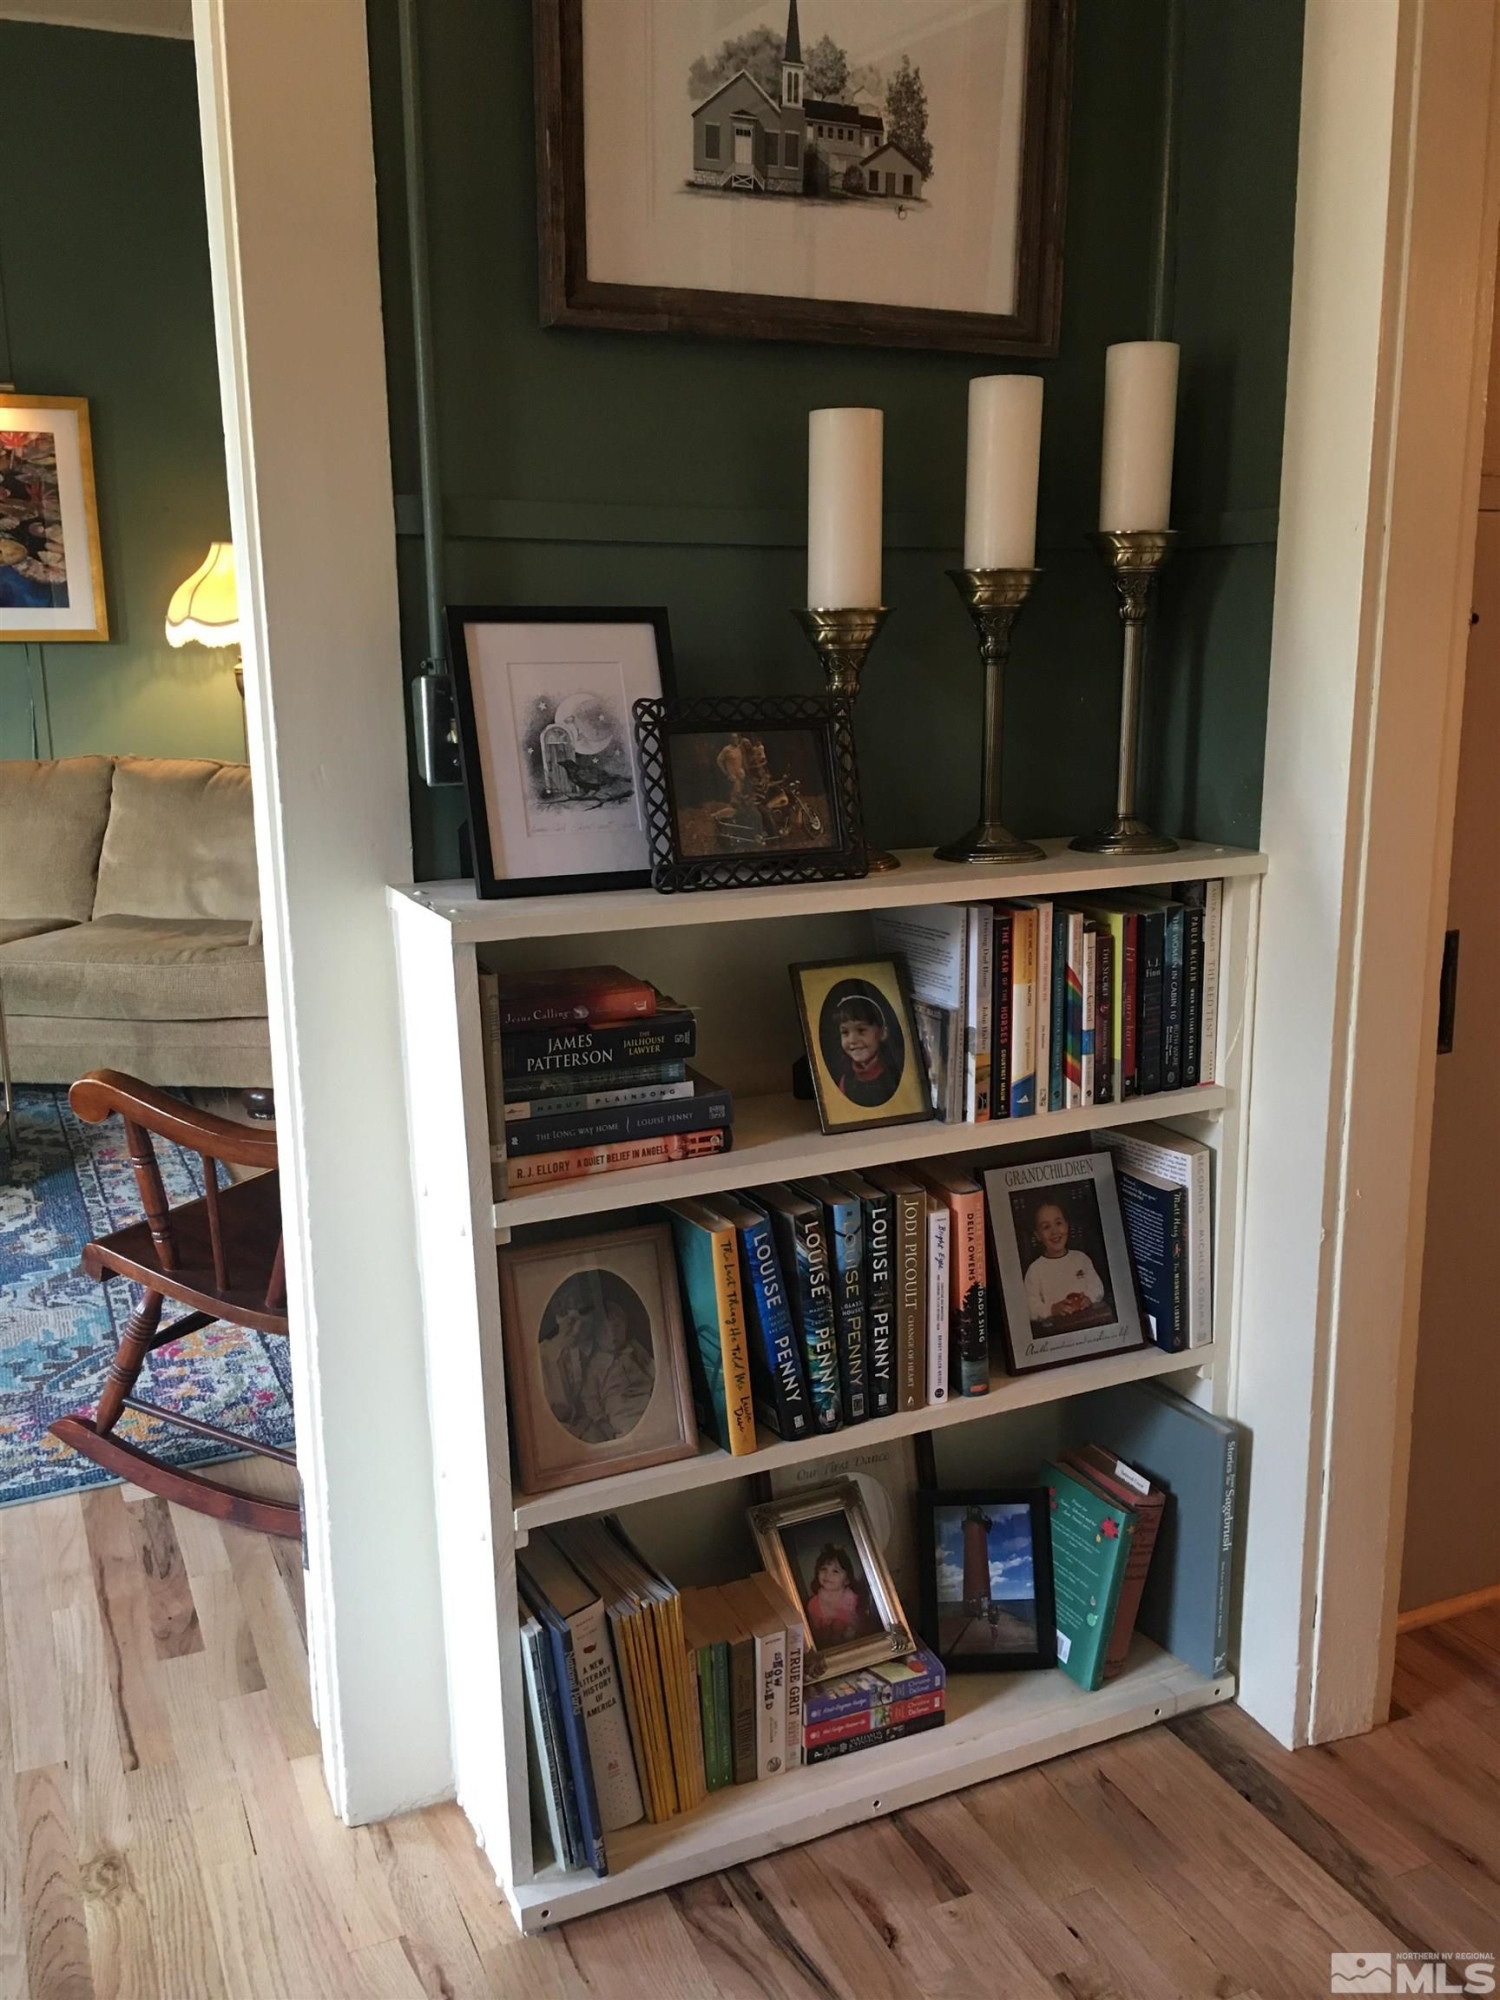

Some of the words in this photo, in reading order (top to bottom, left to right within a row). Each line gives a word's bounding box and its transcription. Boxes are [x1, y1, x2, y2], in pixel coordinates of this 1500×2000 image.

[1002, 926, 1010, 944] THE
[1190, 916, 1198, 944] PAULA
[1002, 948, 1010, 974] YEAR
[1102, 948, 1110, 963] THE
[1171, 934, 1179, 969] WOMAN
[1170, 970, 1178, 980] IN
[1208, 985, 1216, 1002] RED
[505, 1013, 531, 1024] Jesus
[532, 1008, 571, 1020] Calling
[1086, 995, 1094, 1022] Good
[1170, 1010, 1176, 1020] 10
[1000, 1006, 1009, 1044] HORSES
[548, 1033, 593, 1054] JAMES
[624, 1036, 665, 1049] JAILHOUSE
[628, 1044, 661, 1055] LAWYER
[1188, 1035, 1194, 1043] GO
[527, 1048, 613, 1072] PATTERSON
[595, 1088, 676, 1104] PLAINSONG
[536, 1132, 552, 1141] THE
[552, 1126, 576, 1140] LONG
[578, 1126, 594, 1138] WAY
[596, 1122, 619, 1133] HOME
[637, 1116, 665, 1128] LOUISE
[668, 1112, 694, 1124] PENNY
[516, 1166, 526, 1178] R.
[527, 1164, 534, 1177] J.
[537, 1160, 570, 1176] ELLORY
[577, 1157, 582, 1168] A
[583, 1153, 604, 1168] QUIET
[606, 1149, 631, 1164] BELIEF
[632, 1148, 640, 1158] IN
[642, 1144, 669, 1158] ANGELS
[1004, 1158, 1094, 1187] GRANDCHILDREN
[1198, 1155, 1206, 1214] BECOMING
[1173, 1192, 1182, 1214] Matt
[904, 1200, 918, 1236] JODI
[966, 1213, 975, 1242] DELIA
[1171, 1218, 1180, 1238] Haig
[872, 1208, 888, 1282] LOUISE
[936, 1224, 946, 1249] Bright
[804, 1221, 826, 1298] LOUISE
[842, 1219, 860, 1298] LOUISE
[968, 1246, 976, 1281] OWENS
[1198, 1230, 1206, 1282] MICHELLE
[724, 1264, 736, 1286] Last
[904, 1242, 918, 1310] PICOULT
[725, 1292, 740, 1325] Thing
[753, 1232, 782, 1309] LOUISE
[774, 1336, 802, 1402] PENNY
[842, 1306, 864, 1316] HOUSES
[844, 1301, 862, 1310] GLASS
[730, 1328, 740, 1342] He
[874, 1312, 890, 1380] PENNY
[732, 1344, 746, 1372] Told
[814, 1326, 836, 1394] PENNY
[846, 1316, 863, 1387] PENNY
[908, 1350, 914, 1360] OF
[796, 1466, 818, 1482] Our
[824, 1459, 850, 1476] First
[855, 1452, 890, 1466] Dance
[1226, 1440, 1236, 1474] Stories
[1222, 1489, 1236, 1552] Sagebrush
[565, 1650, 580, 1690] National
[580, 1666, 612, 1688] LITERARY
[582, 1666, 588, 1675] A
[590, 1657, 605, 1672] NEW
[773, 1652, 784, 1687] SNOW
[789, 1648, 800, 1683] TRUE
[582, 1676, 612, 1698] HISTORY
[595, 1693, 604, 1702] OF
[764, 1671, 774, 1710] BLIND
[570, 1690, 582, 1716] Parks
[586, 1697, 617, 1718] AMERICA
[788, 1686, 800, 1716] GRIT
